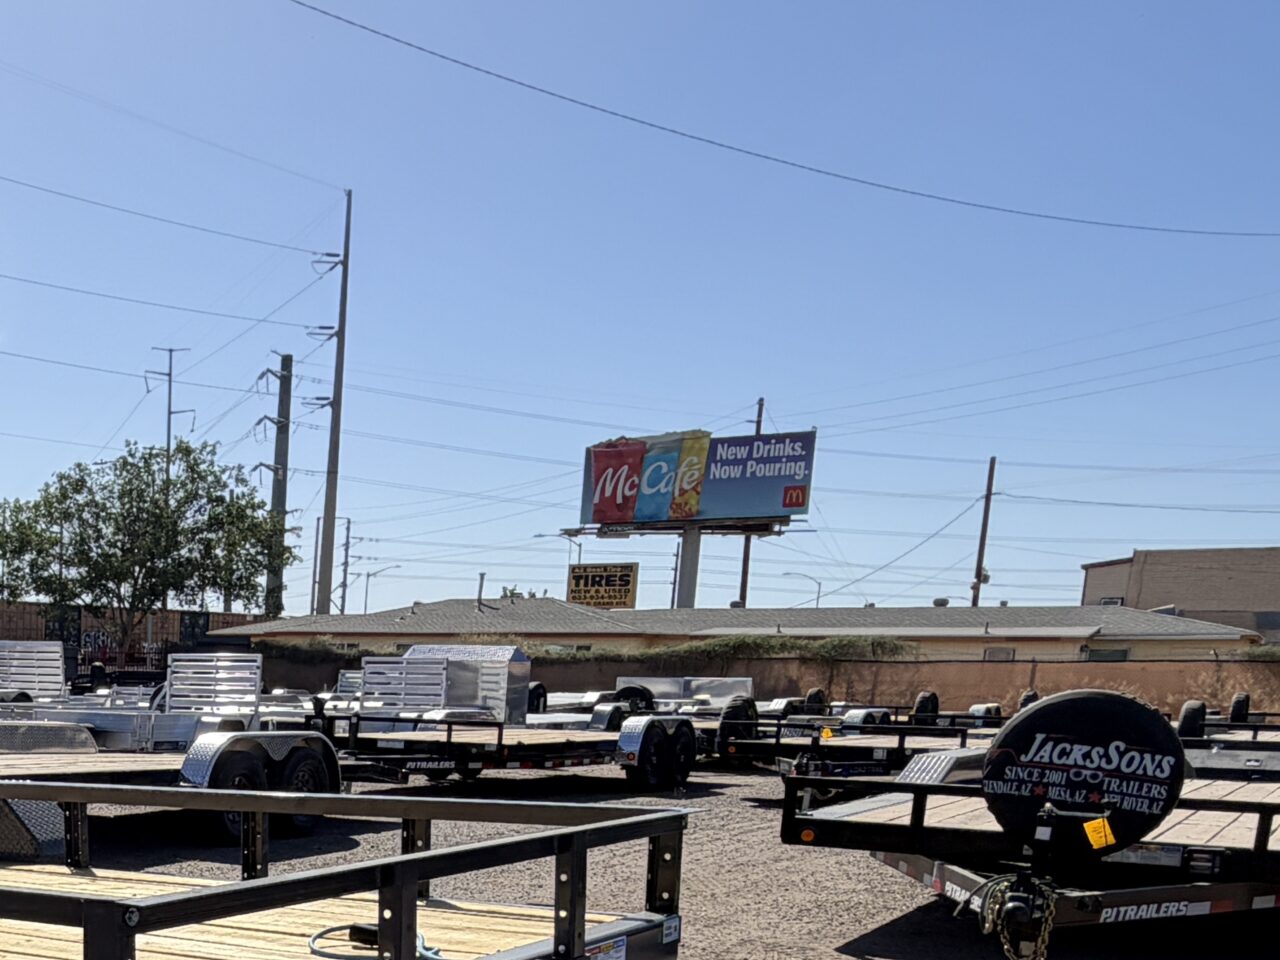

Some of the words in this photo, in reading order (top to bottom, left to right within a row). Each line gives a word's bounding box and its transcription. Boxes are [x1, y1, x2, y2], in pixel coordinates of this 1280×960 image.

[716, 443, 749, 460] New
[752, 438, 806, 458] Drinks.
[593, 456, 701, 504] McCafé
[710, 462, 743, 479] Now
[746, 458, 809, 480] Pouring.
[572, 574, 631, 588] TIRES
[416, 761, 456, 769] TRAILERS
[1004, 766, 1042, 782] SINCE
[1042, 769, 1068, 785] 2001
[1102, 777, 1168, 799] TRAILERS
[1100, 907, 1117, 923] PJ
[1118, 901, 1189, 922] TRAILERS
